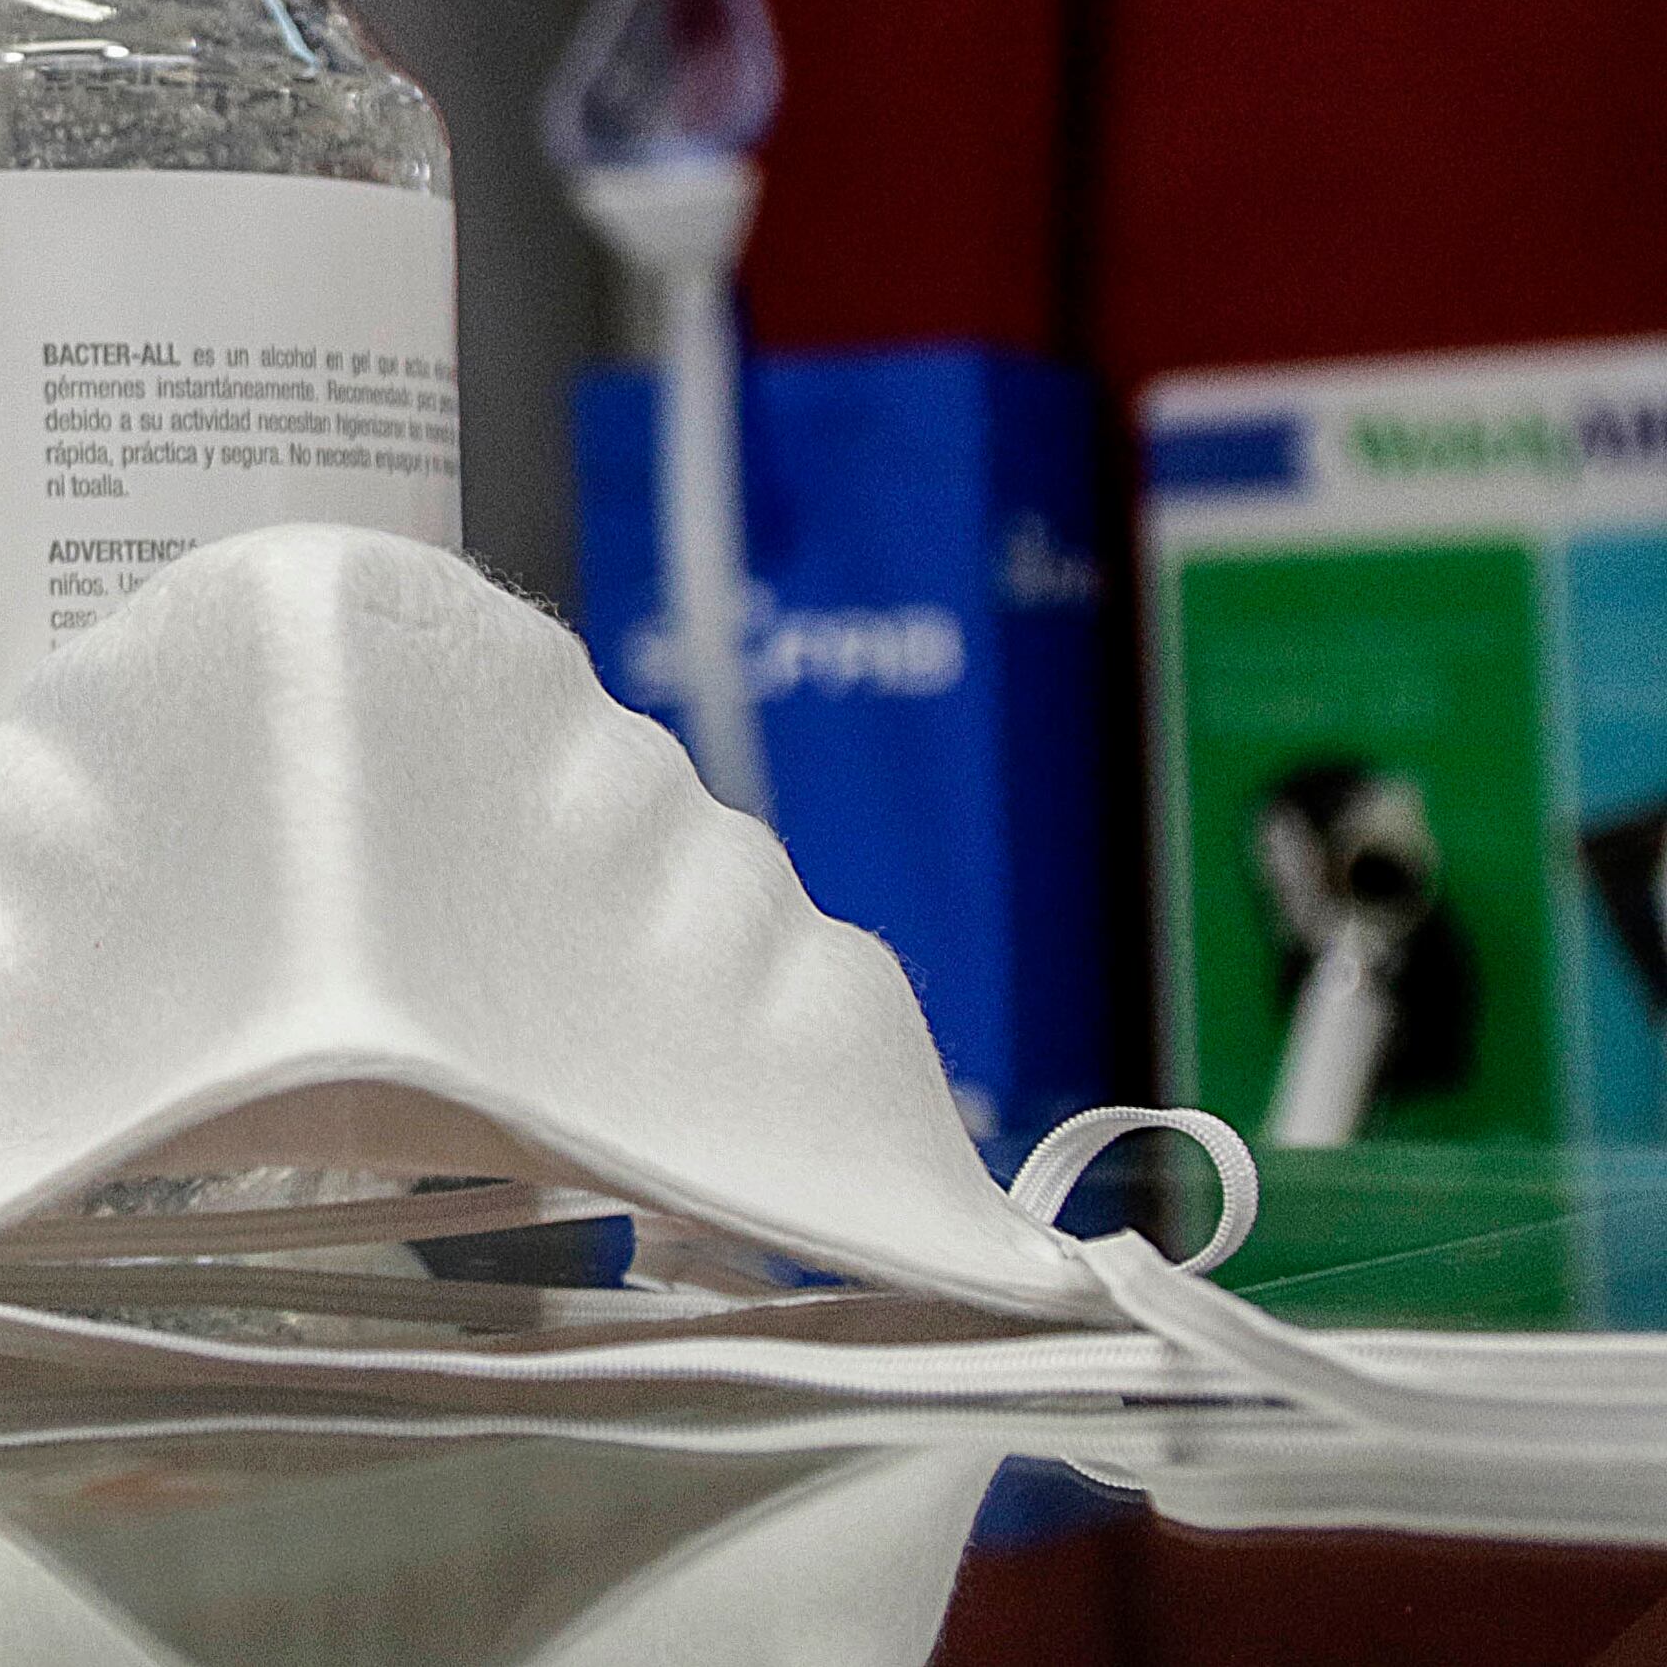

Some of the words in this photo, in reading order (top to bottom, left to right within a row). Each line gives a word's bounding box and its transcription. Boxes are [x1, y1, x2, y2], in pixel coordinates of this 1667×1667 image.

[43, 342, 181, 367] BACTER-ALL
[193, 347, 215, 367] es
[227, 346, 249, 367] un
[261, 344, 317, 369] alcohol
[326, 350, 344, 370] en
[352, 349, 371, 378] gel
[44, 374, 146, 404] gérmenes
[157, 374, 319, 401] instantáneamente.
[45, 407, 112, 432] debido
[120, 411, 133, 432] a
[140, 411, 163, 432] su
[171, 407, 251, 432] actividad
[258, 410, 332, 434] necesitan
[46, 440, 114, 470] rápida,
[121, 440, 198, 470] práctica
[204, 444, 215, 470] y
[221, 444, 283, 470] segura.
[290, 441, 312, 467] No
[317, 443, 372, 469] necesita
[46, 473, 65, 498] ni
[71, 473, 129, 498] toalla.
[49, 570, 109, 597] niños.
